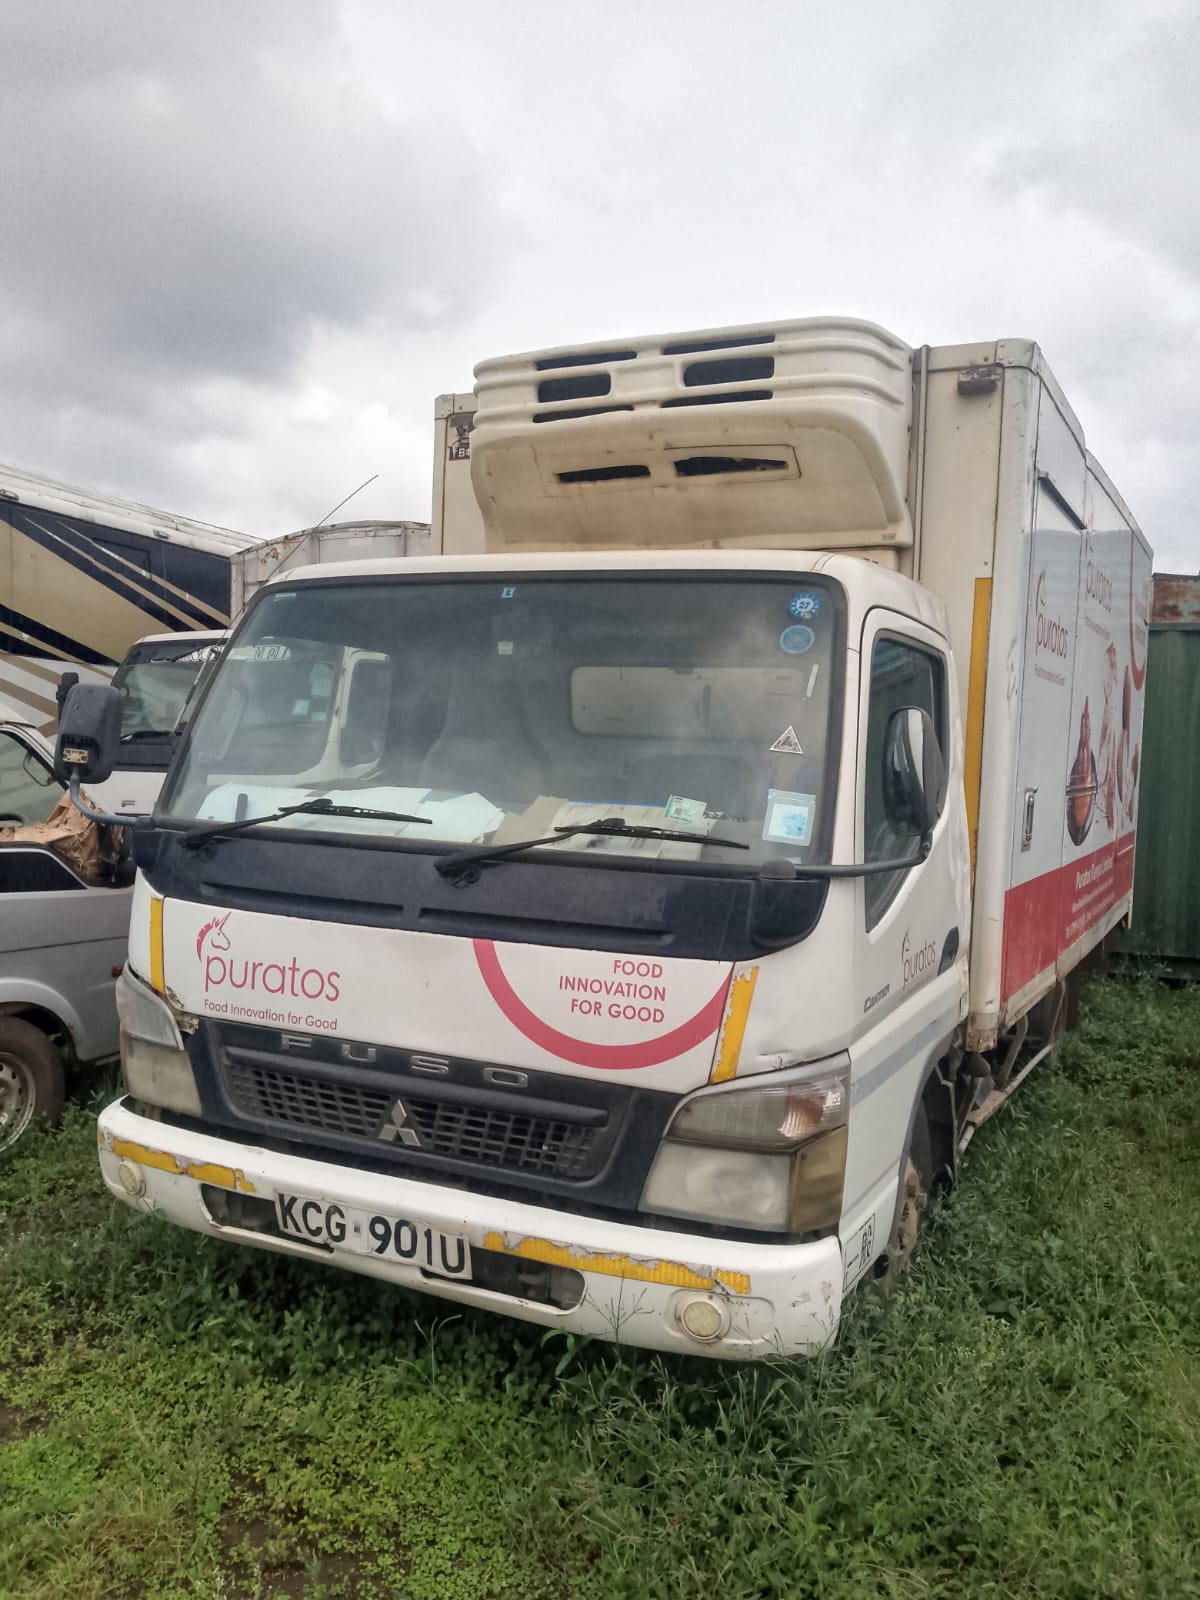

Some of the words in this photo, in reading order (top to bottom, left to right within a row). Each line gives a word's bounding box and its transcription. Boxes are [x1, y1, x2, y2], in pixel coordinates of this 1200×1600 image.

[799, 601, 810, 609] 27
[205, 955, 341, 1002] puratos
[613, 959, 663, 979] FOOD
[559, 975, 666, 1002] INNOVATION
[204, 999, 228, 1013] Food
[230, 1003, 285, 1023] Innovation
[287, 1012, 302, 1025] for
[305, 1015, 338, 1031] Good
[571, 998, 602, 1016] FOR
[608, 1003, 665, 1023] GOOD
[281, 1034, 529, 1088] FUSO
[278, 1193, 347, 1243] KCG
[369, 1215, 466, 1274] 901U
